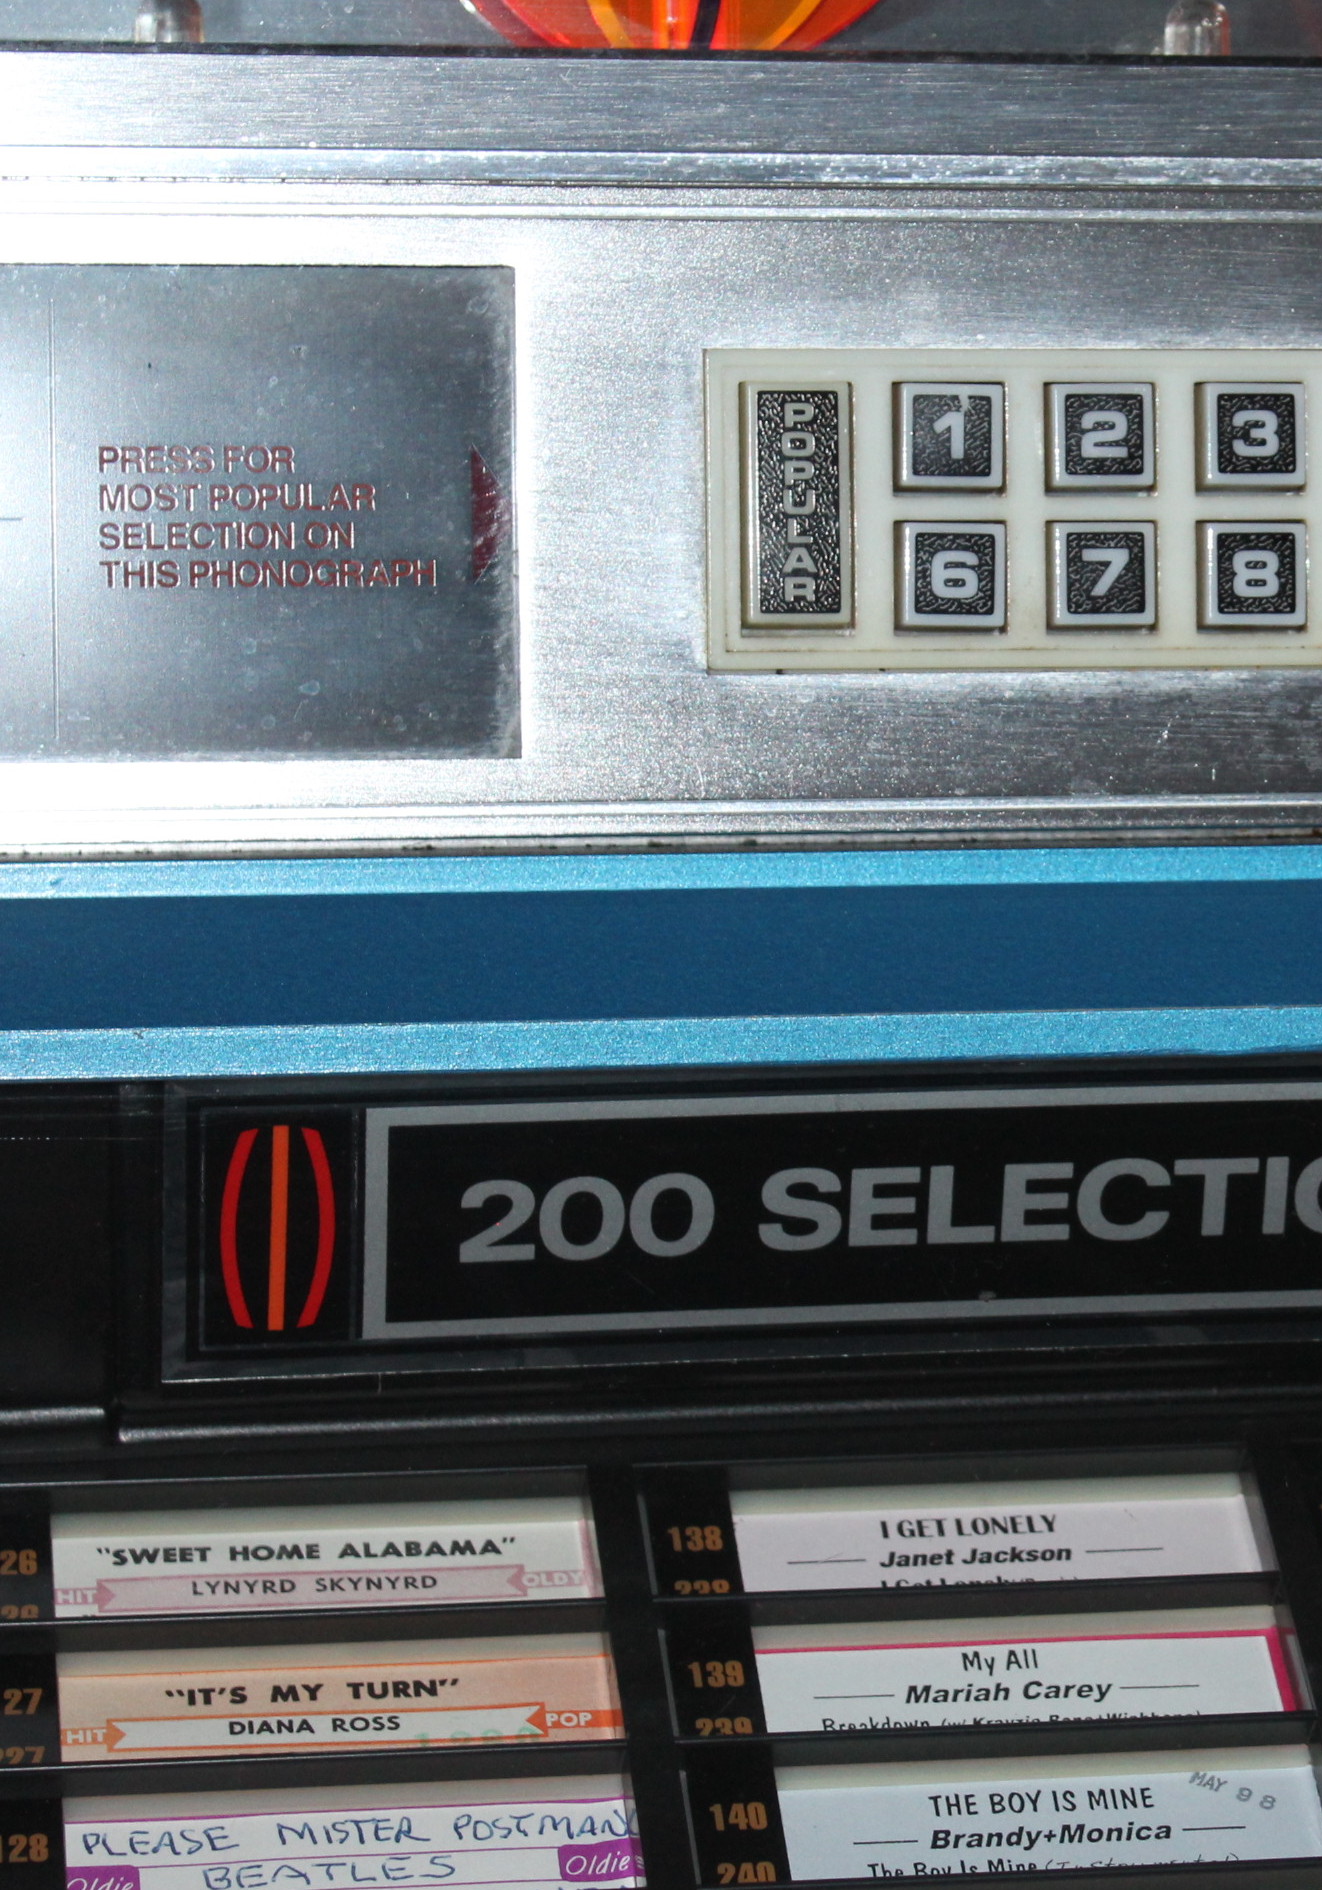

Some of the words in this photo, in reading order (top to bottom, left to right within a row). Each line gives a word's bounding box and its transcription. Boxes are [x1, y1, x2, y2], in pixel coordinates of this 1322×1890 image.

[932, 411, 966, 459] 1
[1080, 410, 1129, 459] 2
[1231, 409, 1280, 457] 3
[99, 445, 215, 474] PRESS
[224, 445, 295, 473] FOR
[99, 483, 203, 512] MOST
[209, 483, 376, 511] POPULAR
[780, 402, 820, 602] POPULAR
[99, 521, 295, 550] SELECTION
[303, 521, 355, 549] ON
[99, 560, 181, 589] THIS
[189, 559, 437, 588] PHONOGRAPH
[930, 549, 980, 599] 6
[1081, 547, 1131, 597] 7
[1231, 549, 1280, 598] 8
[459, 1172, 715, 1263] 200
[668, 1525, 723, 1552] 138
[880, 1520, 889, 1539] I
[897, 1518, 946, 1538] GET
[955, 1514, 1056, 1537] LONELY
[229, 1543, 321, 1562] HOME
[879, 1549, 954, 1568] Janet
[961, 1547, 1072, 1564] Jackson
[192, 1580, 296, 1596] LYNYRD
[315, 1576, 437, 1592] SKYNYRD
[522, 1571, 583, 1588] OLDY
[57, 1589, 97, 1604] HIT
[688, 1660, 744, 1688] 139
[961, 1651, 995, 1677] My
[1006, 1649, 1039, 1671] All
[3, 1688, 43, 1716] 27
[271, 1683, 324, 1703] MY
[905, 1683, 1010, 1704] Mariah
[1022, 1681, 1113, 1703] Carey
[229, 1719, 315, 1736] DIANA
[332, 1716, 400, 1733] ROSS
[546, 1712, 592, 1727] POP
[66, 1729, 107, 1744] HIT
[1189, 1771, 1228, 1793] MAY
[928, 1793, 979, 1817] THE
[989, 1790, 1042, 1813] BOY
[1052, 1790, 1076, 1812] IS
[1087, 1787, 1154, 1810] MINE
[709, 1802, 768, 1831] 140
[82, 1826, 240, 1856] PLEASE
[276, 1816, 431, 1846] MISTER
[930, 1822, 1172, 1850] Brandy+Monica
[203, 1855, 456, 1890] BEATLES
[565, 1852, 630, 1877] Oldie
